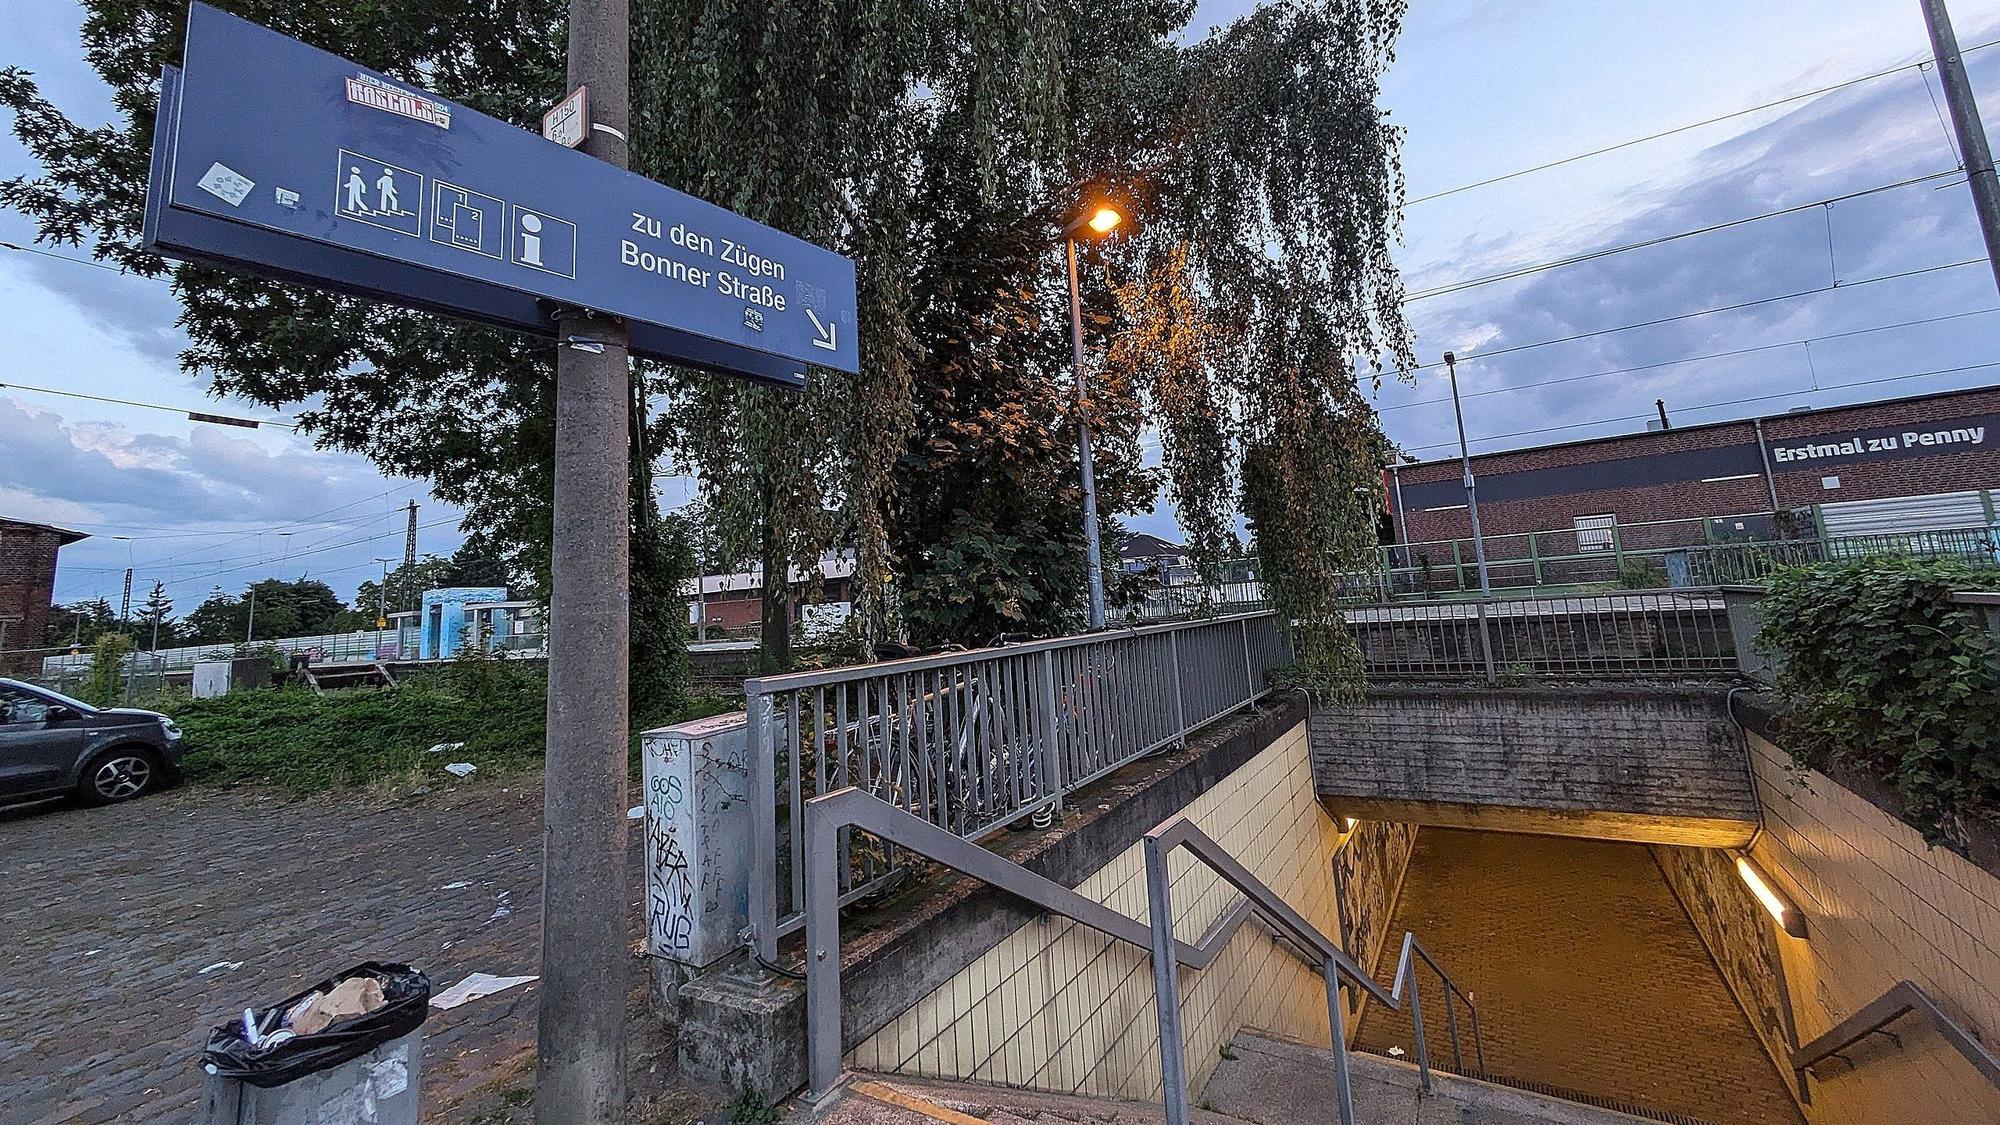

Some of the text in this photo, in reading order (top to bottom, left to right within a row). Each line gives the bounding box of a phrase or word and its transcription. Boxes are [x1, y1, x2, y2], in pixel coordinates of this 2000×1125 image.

[621, 239, 786, 312] Bonner Straße
[631, 212, 785, 281] zu den Zügen
[1773, 427, 1985, 463] Erstmal zu Penny
